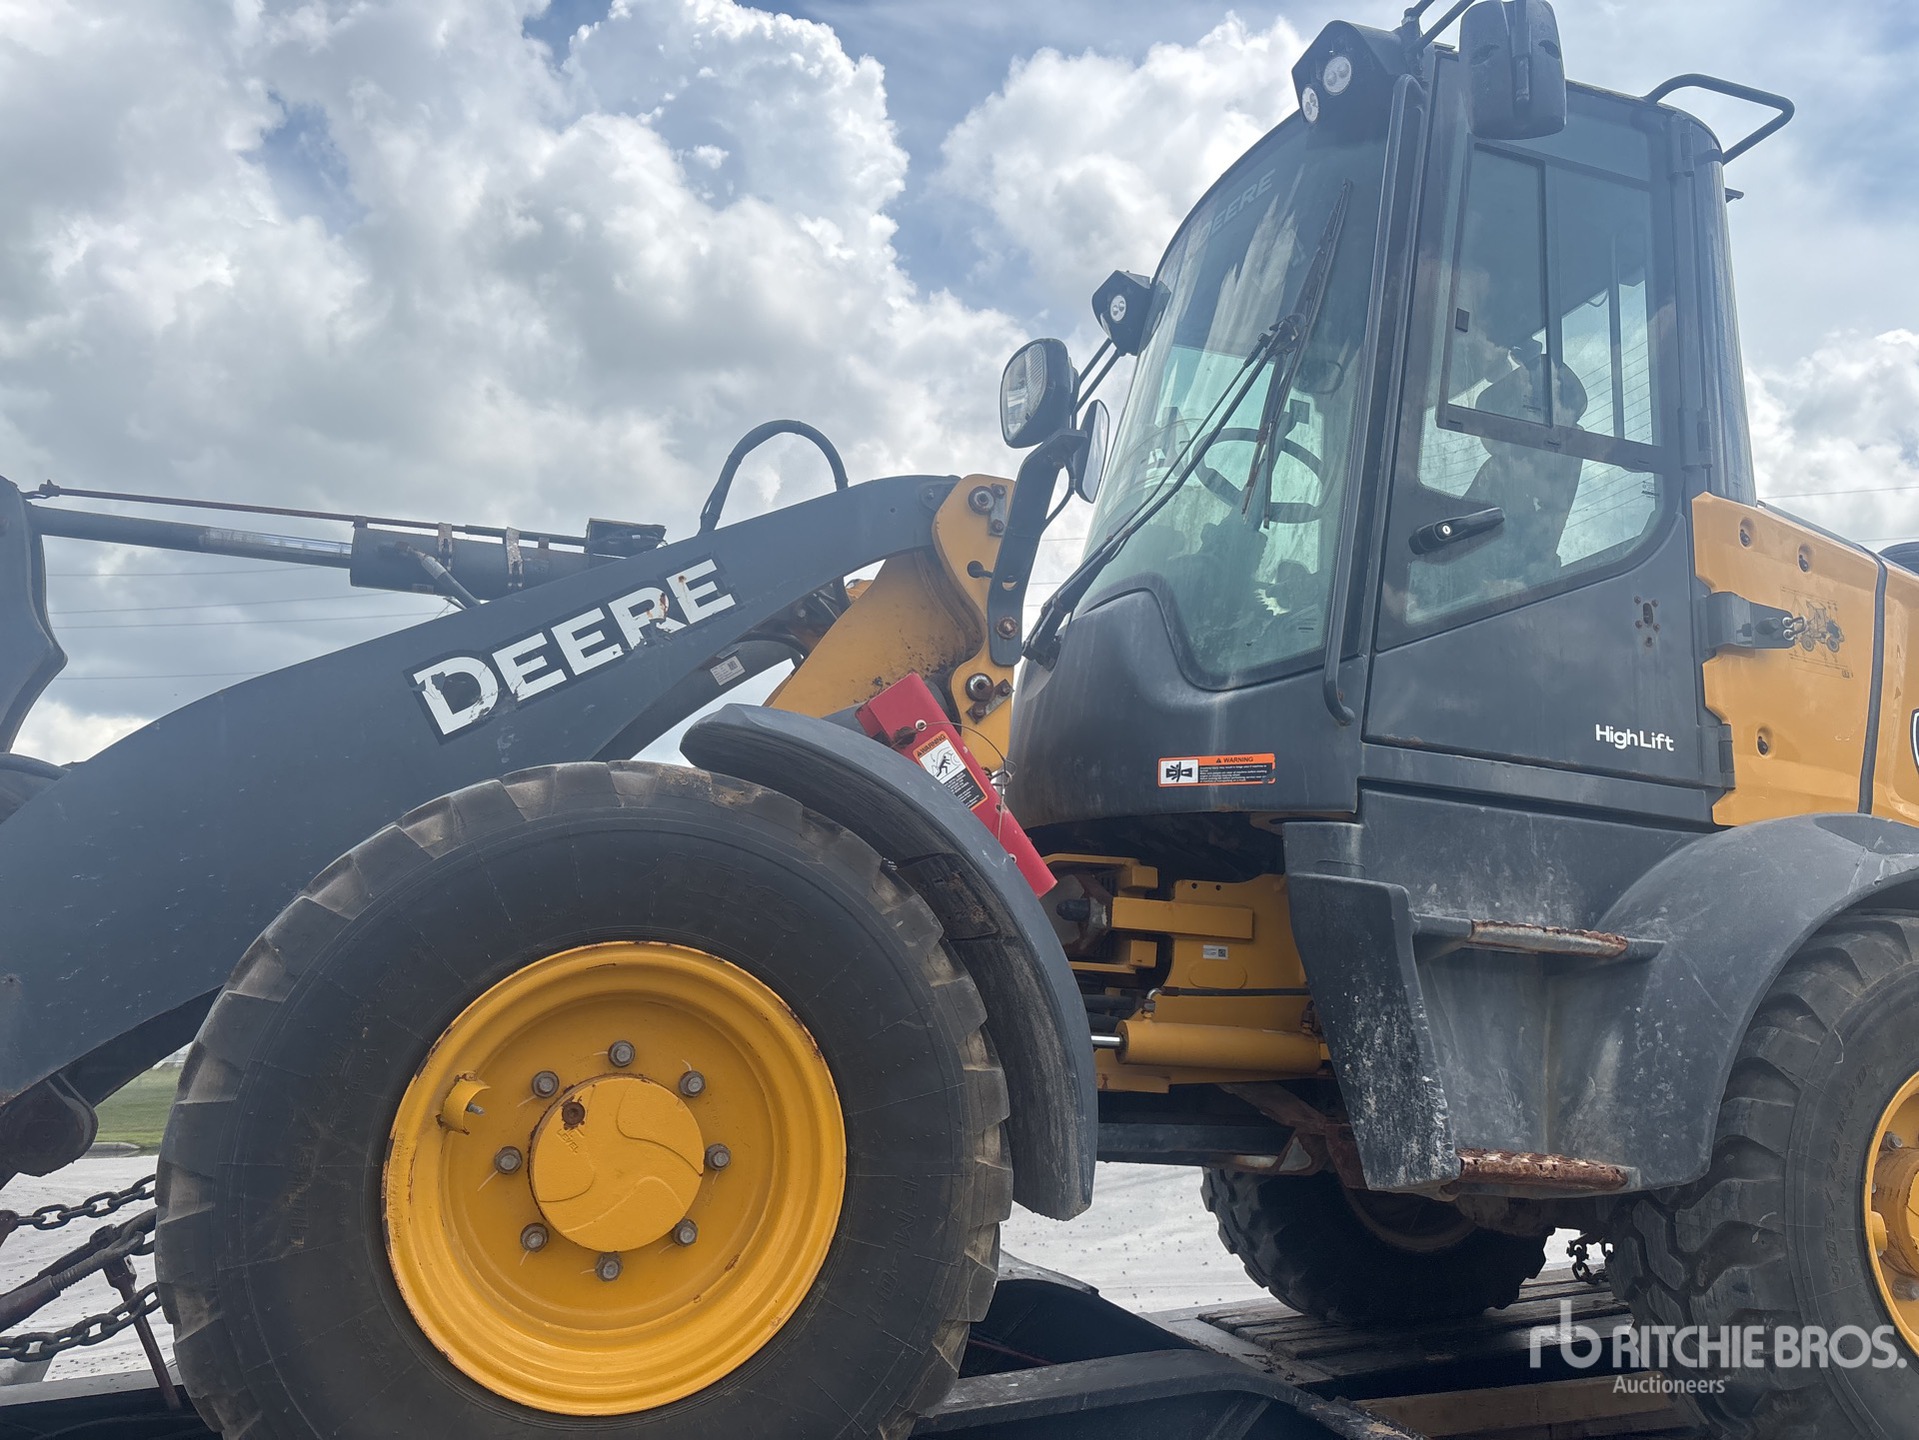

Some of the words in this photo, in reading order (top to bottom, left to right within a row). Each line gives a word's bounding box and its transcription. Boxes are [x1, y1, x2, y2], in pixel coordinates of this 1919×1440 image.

[413, 558, 736, 735] DEERE
[921, 733, 946, 753] WARNING
[1223, 756, 1254, 764] WARNING
